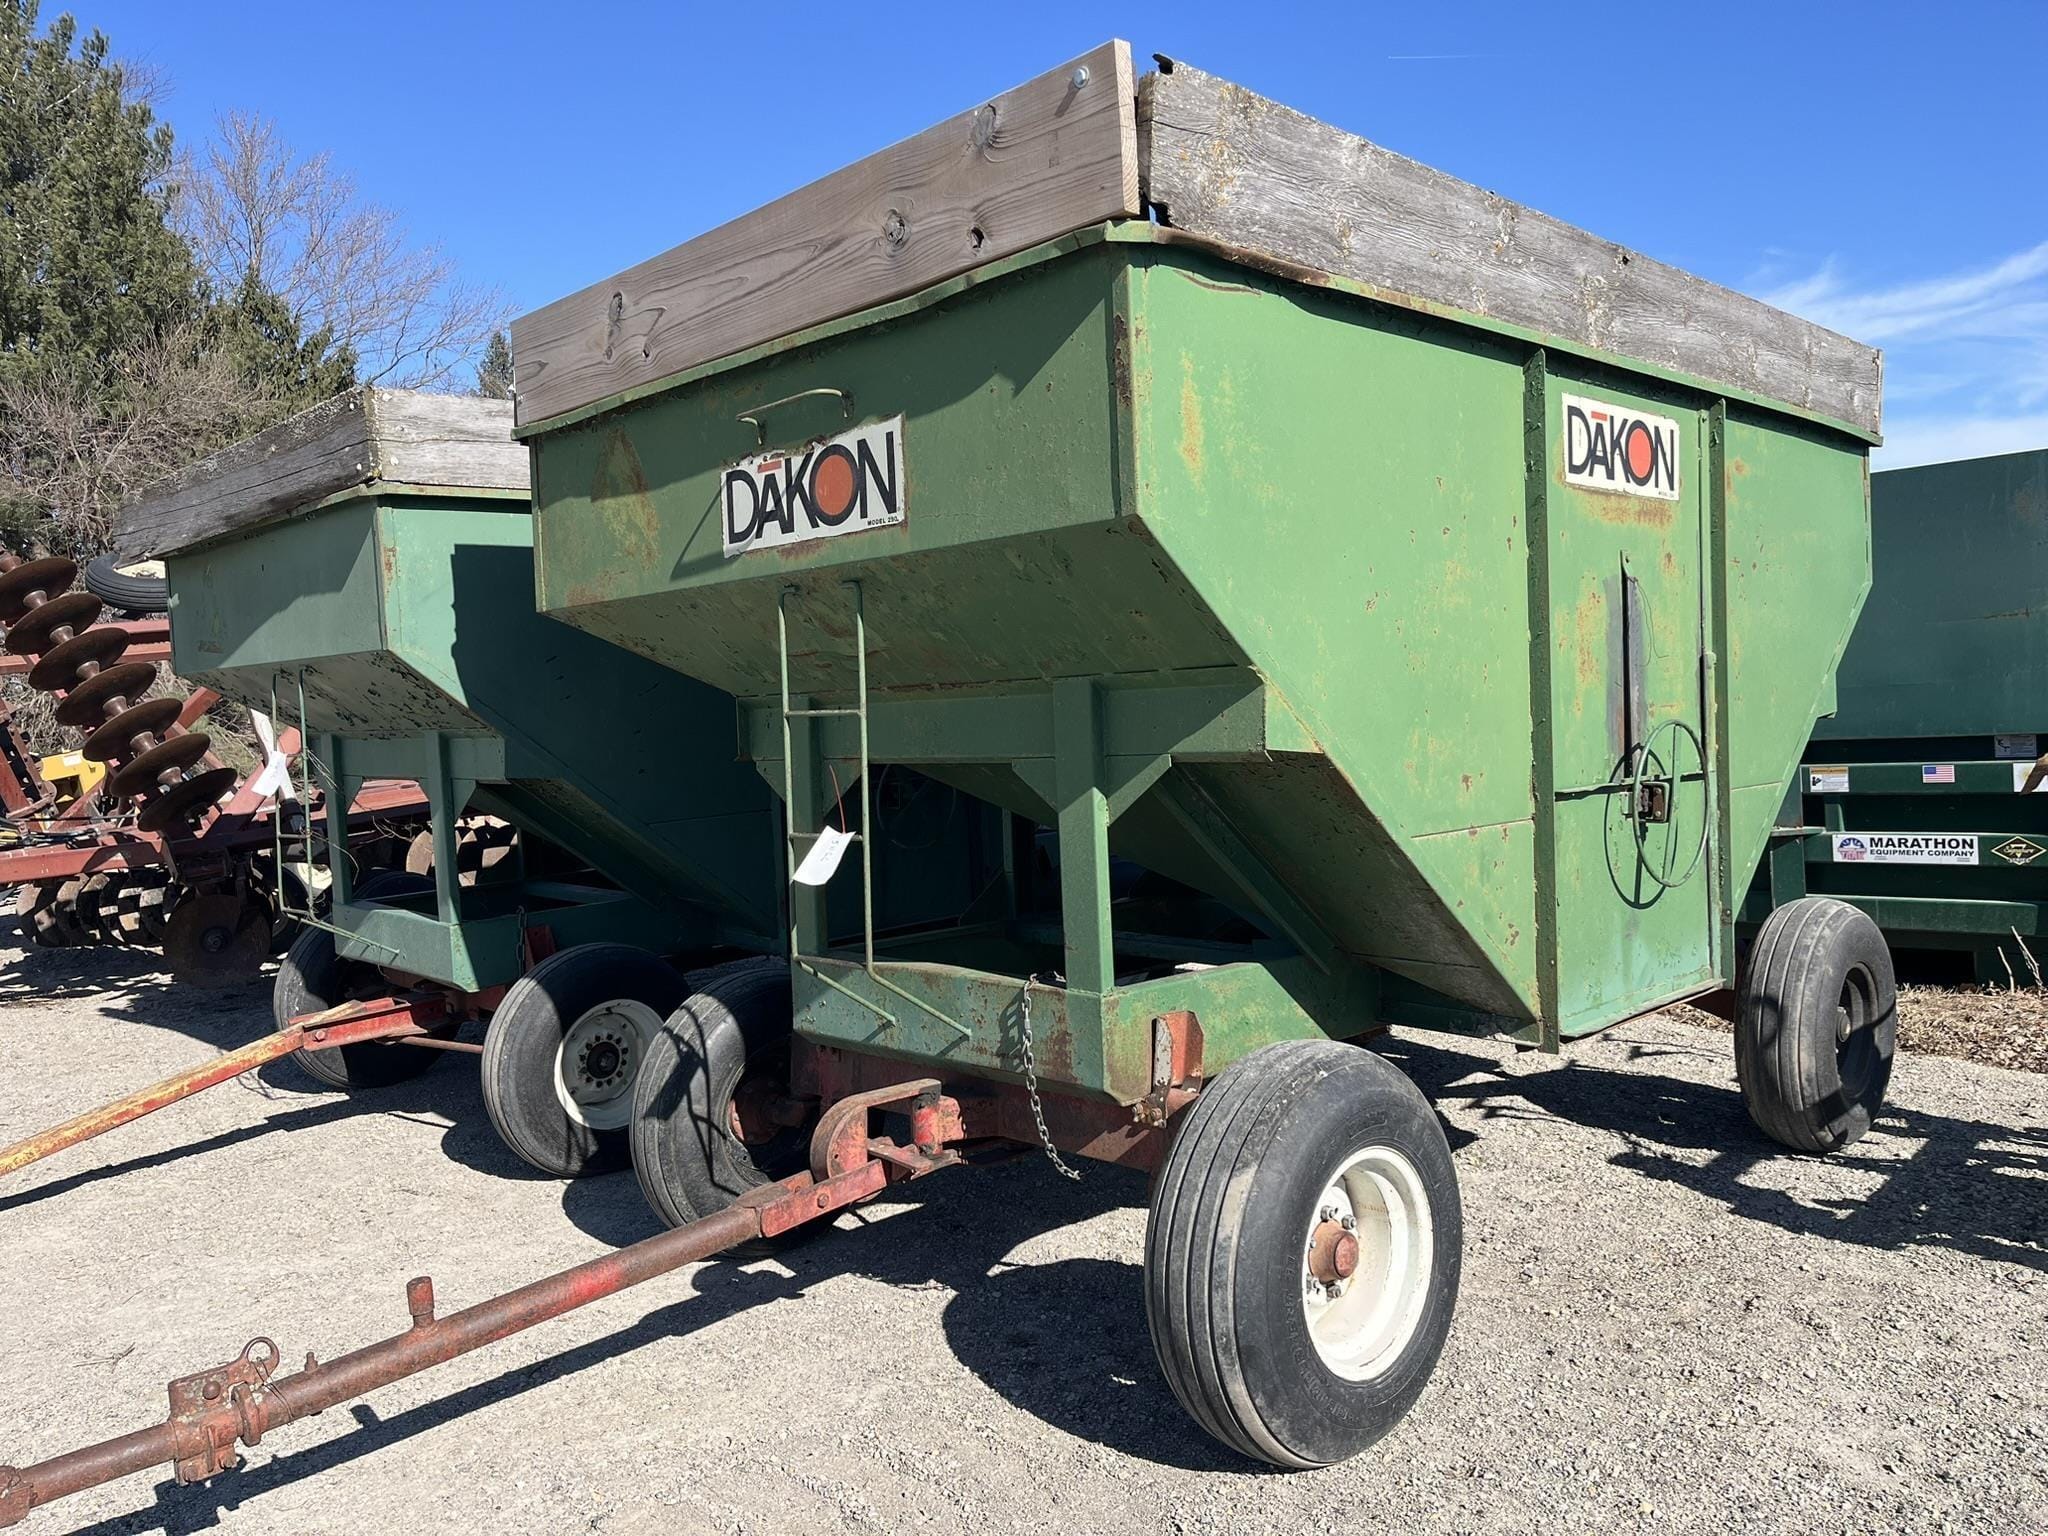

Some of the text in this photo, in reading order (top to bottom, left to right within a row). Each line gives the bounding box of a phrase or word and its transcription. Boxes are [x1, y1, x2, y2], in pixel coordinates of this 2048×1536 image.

[867, 517, 886, 526] MODEL
[1869, 837, 1974, 849] MARATHON
[1927, 849, 1975, 857] COMPANY
